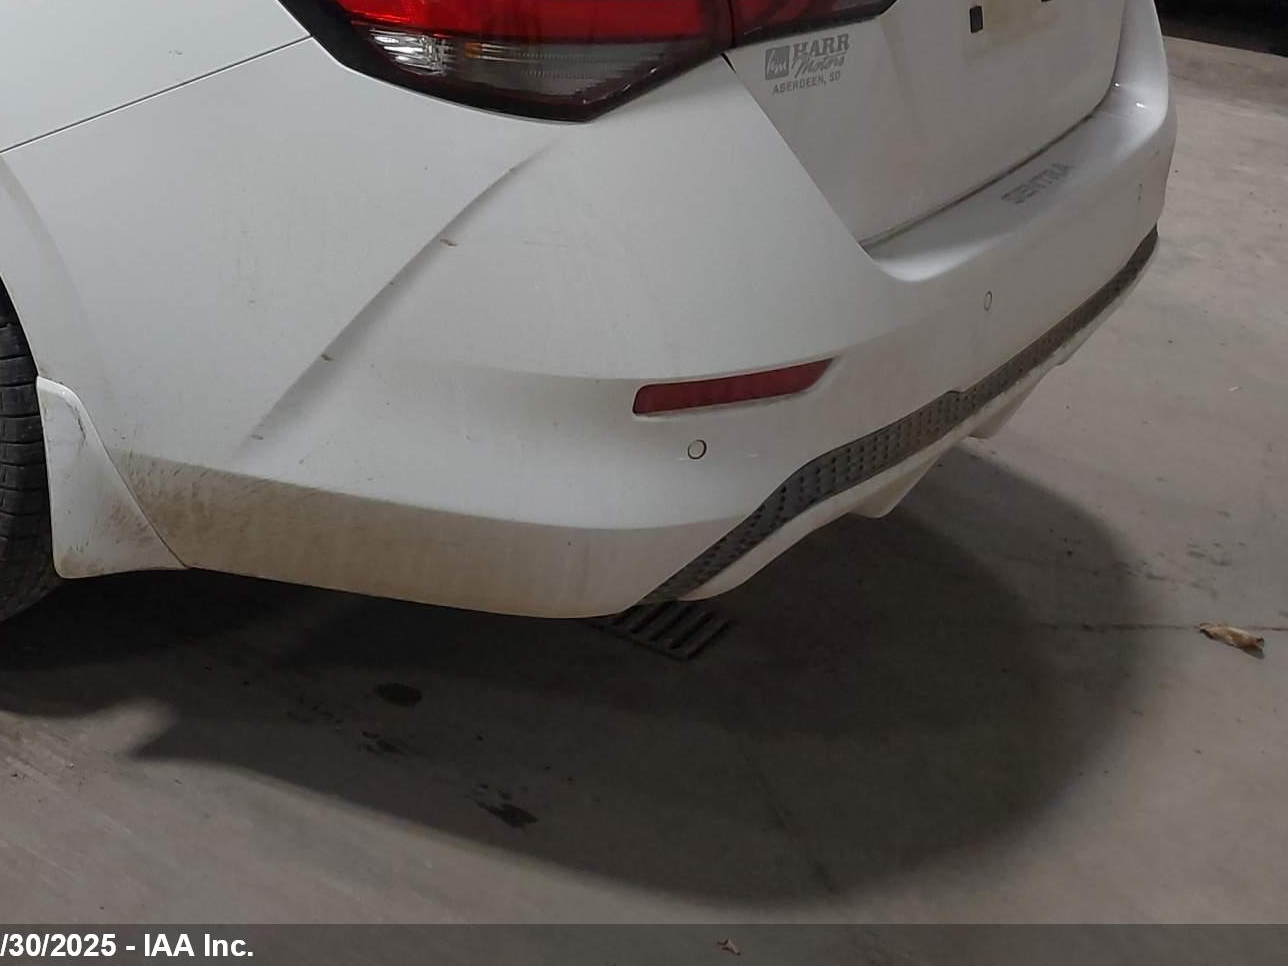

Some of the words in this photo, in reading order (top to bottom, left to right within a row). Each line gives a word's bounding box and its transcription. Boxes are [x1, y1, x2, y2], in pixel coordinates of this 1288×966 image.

[792, 34, 850, 57] HARR
[792, 54, 846, 79] Motors
[772, 73, 827, 95] ABERDEEN,
[830, 70, 841, 83] SD
